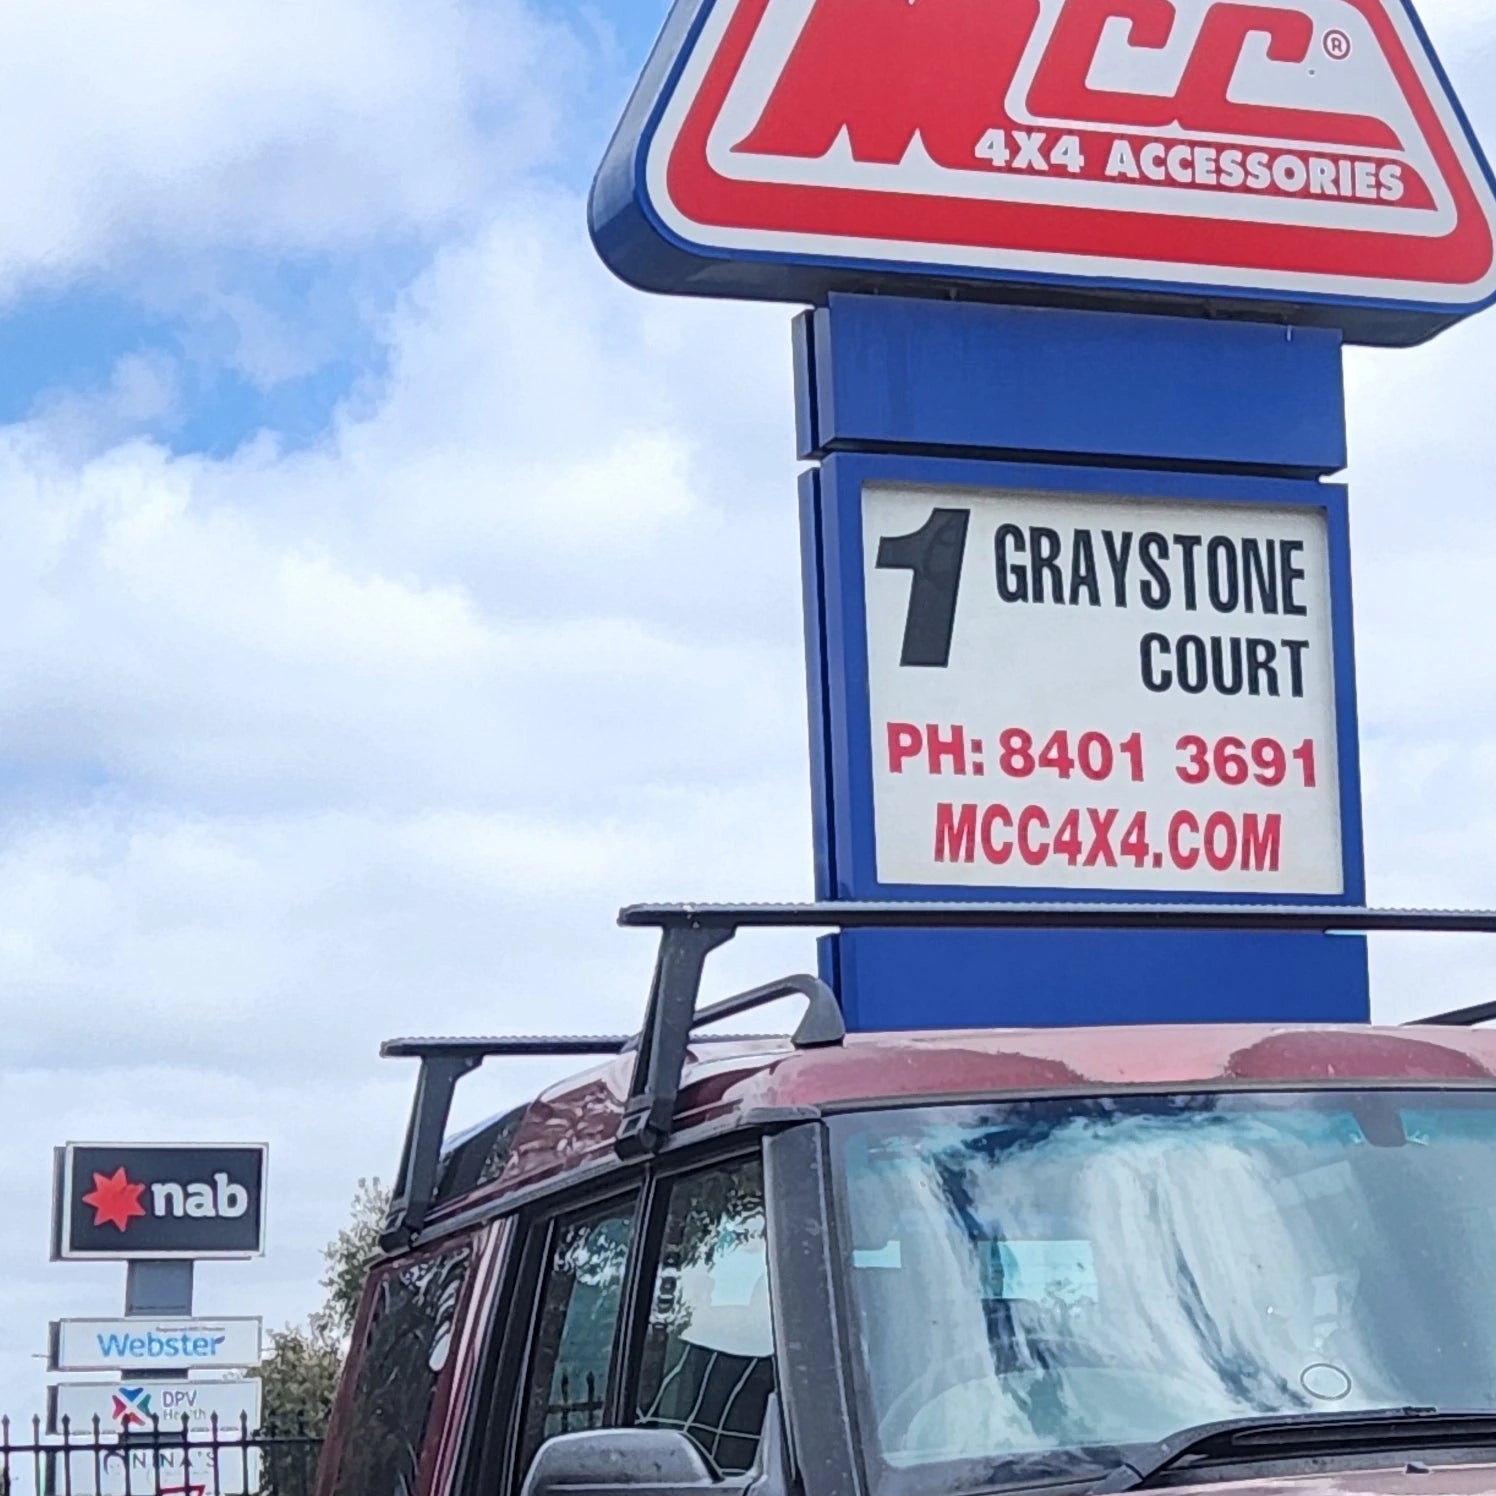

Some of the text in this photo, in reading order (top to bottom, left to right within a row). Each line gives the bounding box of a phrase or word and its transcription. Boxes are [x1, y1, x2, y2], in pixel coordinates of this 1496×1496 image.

[974, 128, 1404, 199] 4X4 ACCESSORIES
[875, 508, 1307, 667] 1 GRAYSTONE
[1140, 632, 1309, 697] COURT
[886, 722, 1316, 787] PH: 8401 3691
[934, 803, 1282, 871] MCC4X4.COM
[151, 1172, 248, 1218] nab
[97, 1332, 225, 1357] Webster
[163, 1390, 197, 1408] DPV
